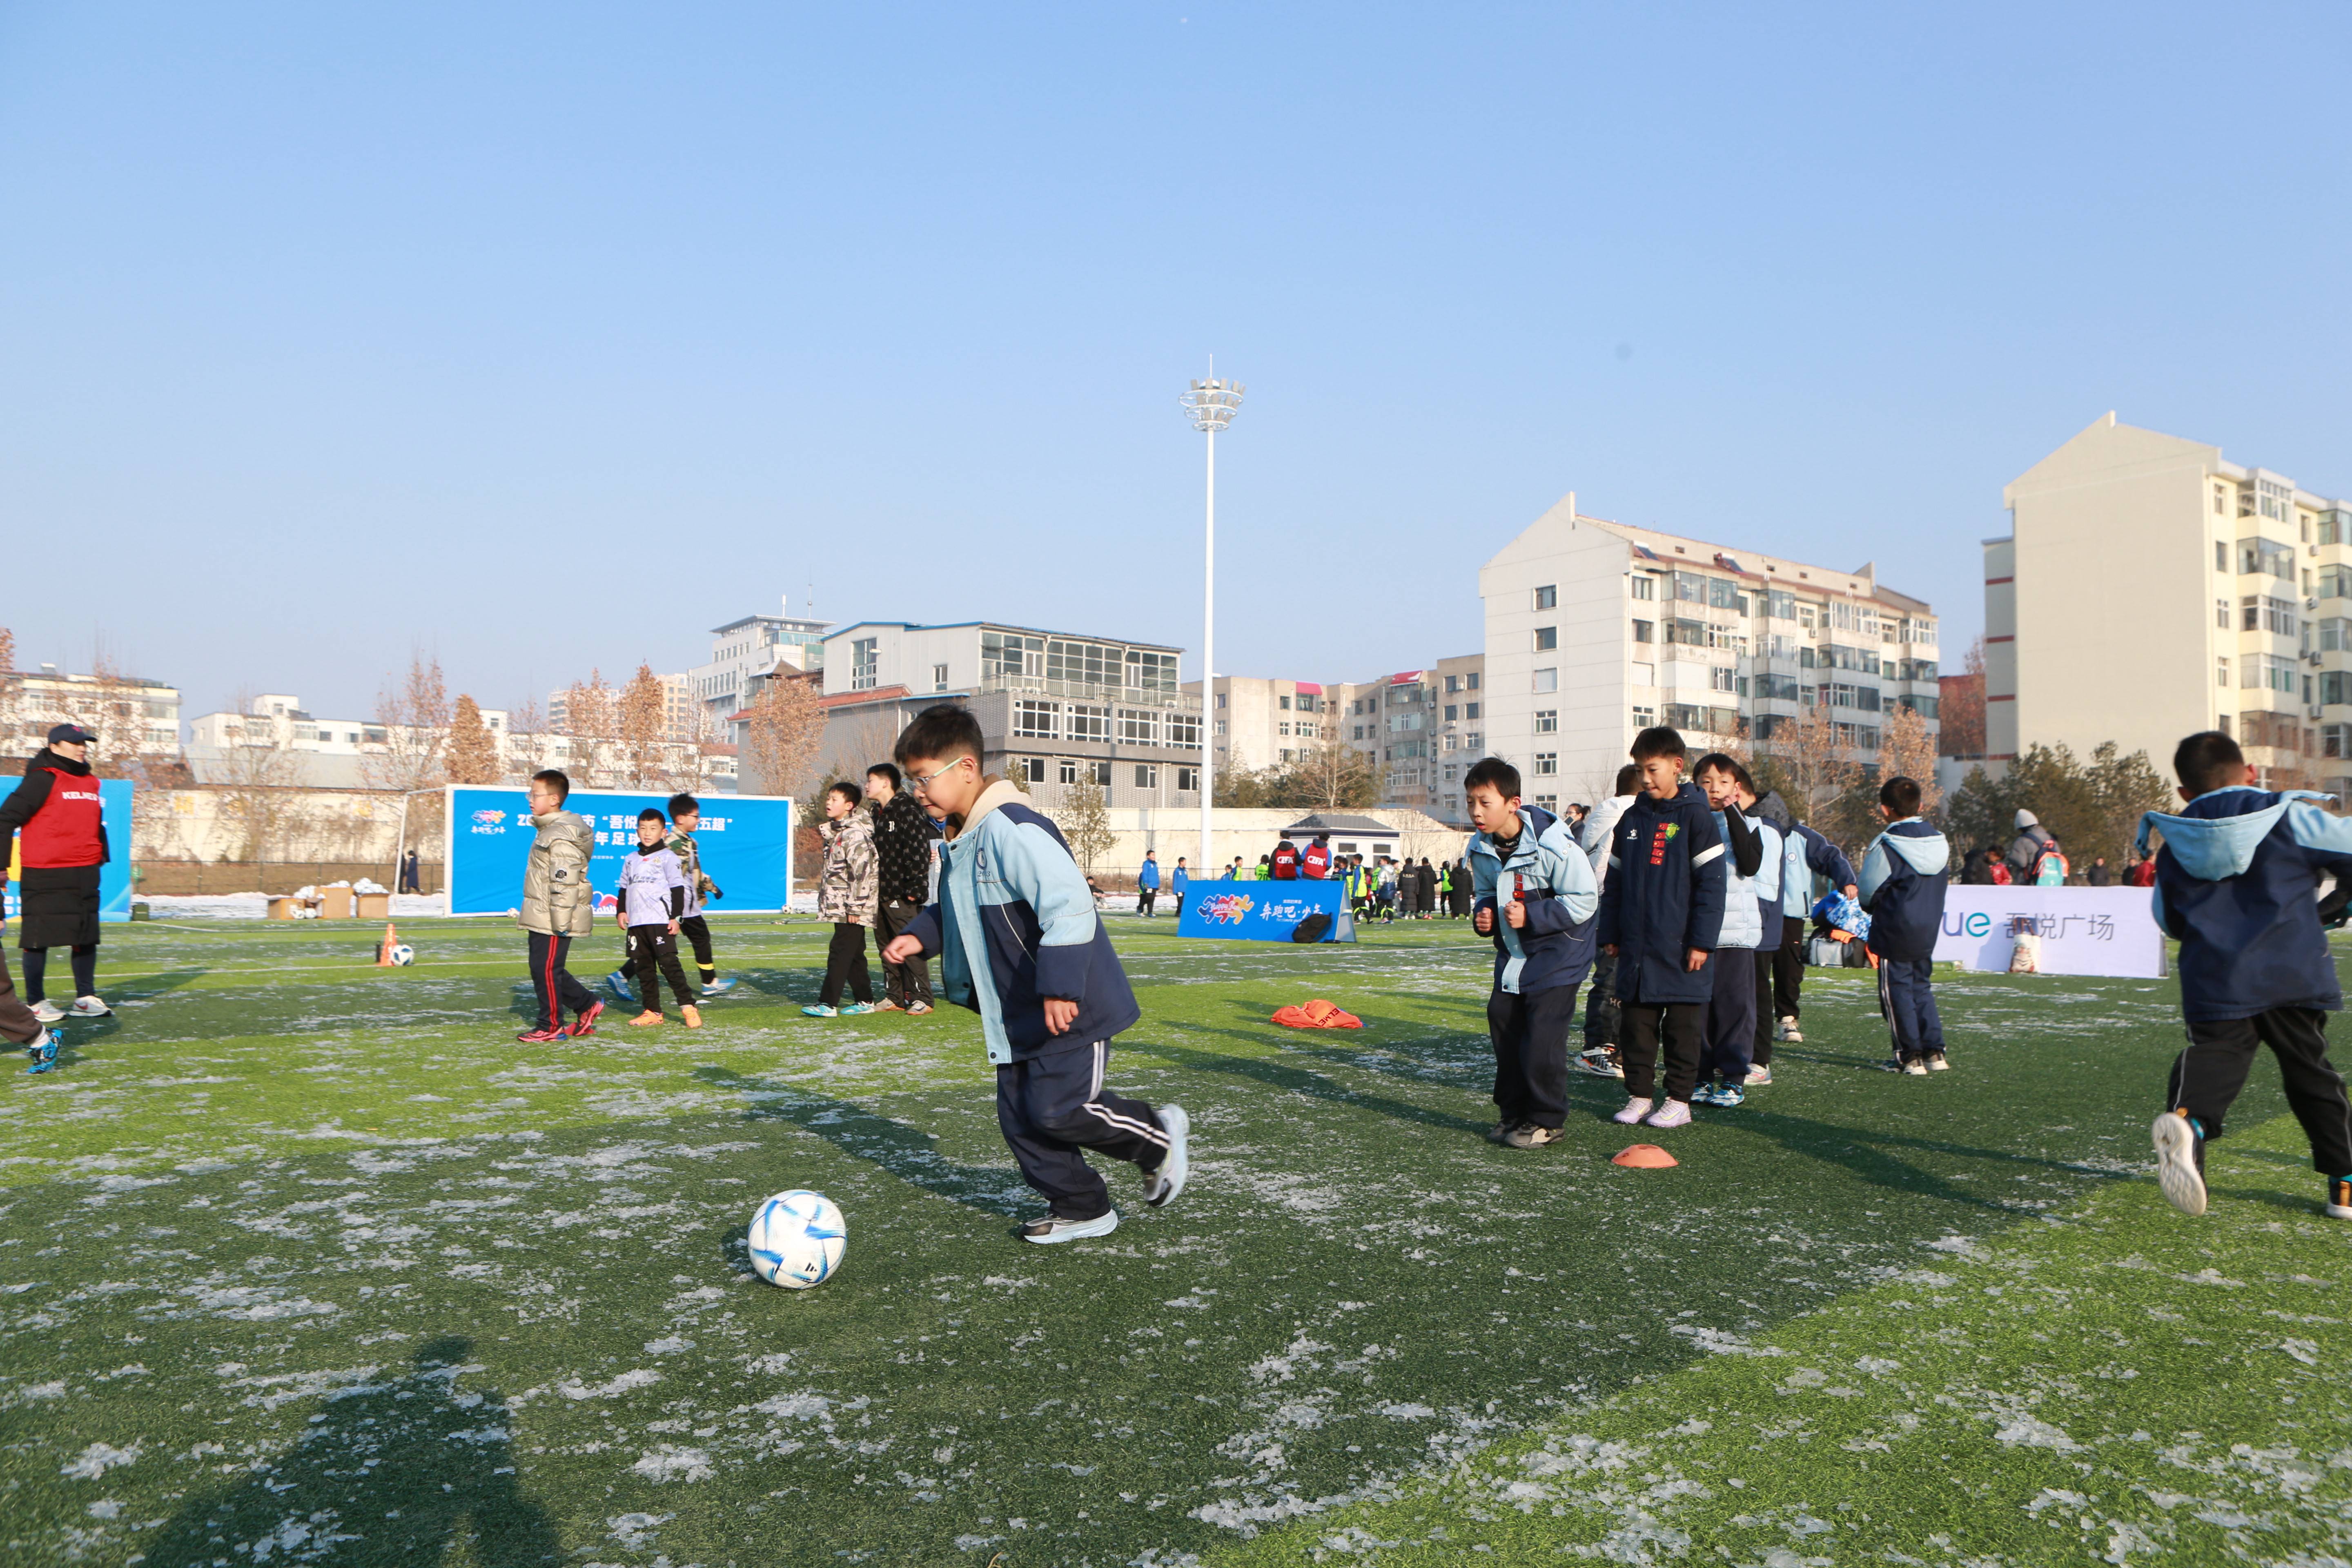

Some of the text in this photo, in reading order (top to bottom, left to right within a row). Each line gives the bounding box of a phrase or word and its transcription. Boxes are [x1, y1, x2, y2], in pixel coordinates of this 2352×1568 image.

[1277, 856, 1294, 864] CZFA
[1307, 855, 1325, 866] CZFA
[628, 935, 637, 951] 9
